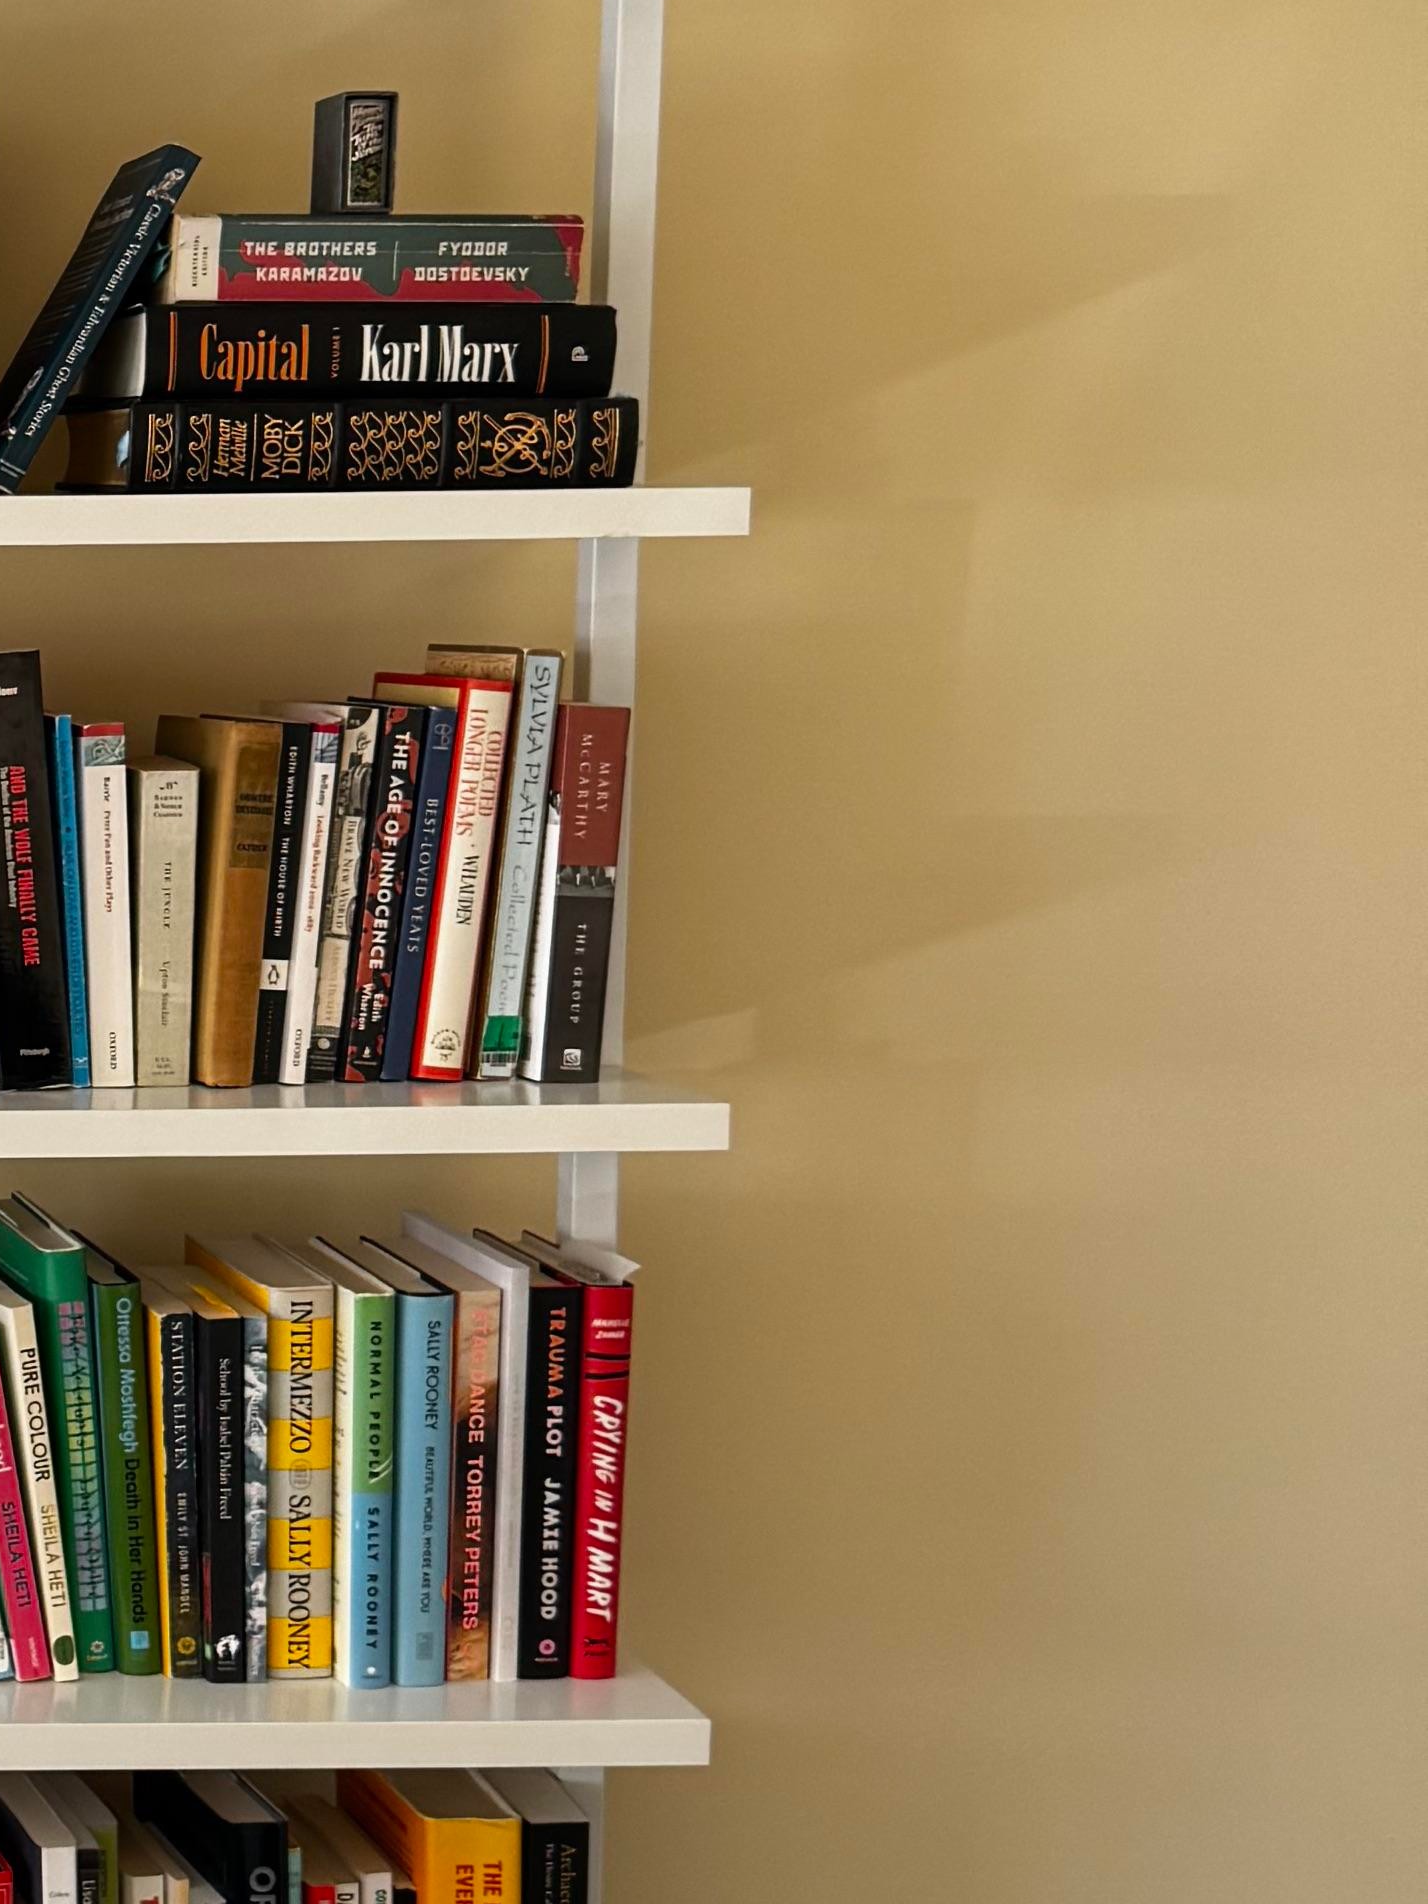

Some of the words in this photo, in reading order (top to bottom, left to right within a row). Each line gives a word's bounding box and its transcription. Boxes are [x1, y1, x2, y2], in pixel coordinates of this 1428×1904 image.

[244, 241, 279, 256] THE
[284, 241, 377, 257] BROTHERS
[256, 267, 363, 282] KARAMAZOV
[415, 267, 529, 283] DOSTOEVSKY
[438, 241, 507, 256] FYODOR
[200, 322, 310, 392] Capital
[360, 325, 429, 382] Karl
[439, 325, 519, 383] Marx
[260, 415, 284, 479] MOBY
[282, 419, 304, 474] DICK
[526, 665, 550, 755] SYLVIA
[517, 762, 541, 845] PLATH
[21, 1348, 41, 1401] PURE
[289, 1300, 313, 1454] INTERMEZZO
[544, 1306, 566, 1399] TRAUMA
[28, 1402, 51, 1482] COLOUR
[544, 1405, 564, 1457] PLOT
[592, 1395, 623, 1485] CRYING
[288, 1495, 311, 1567] SALLY
[542, 1478, 562, 1552] JAMIE
[588, 1521, 618, 1540] H
[594, 1492, 614, 1513] IN
[540, 1559, 558, 1620] HOOD
[584, 1545, 616, 1622] MART
[288, 1573, 312, 1670] ROONEY
[481, 1861, 502, 1893] THE
